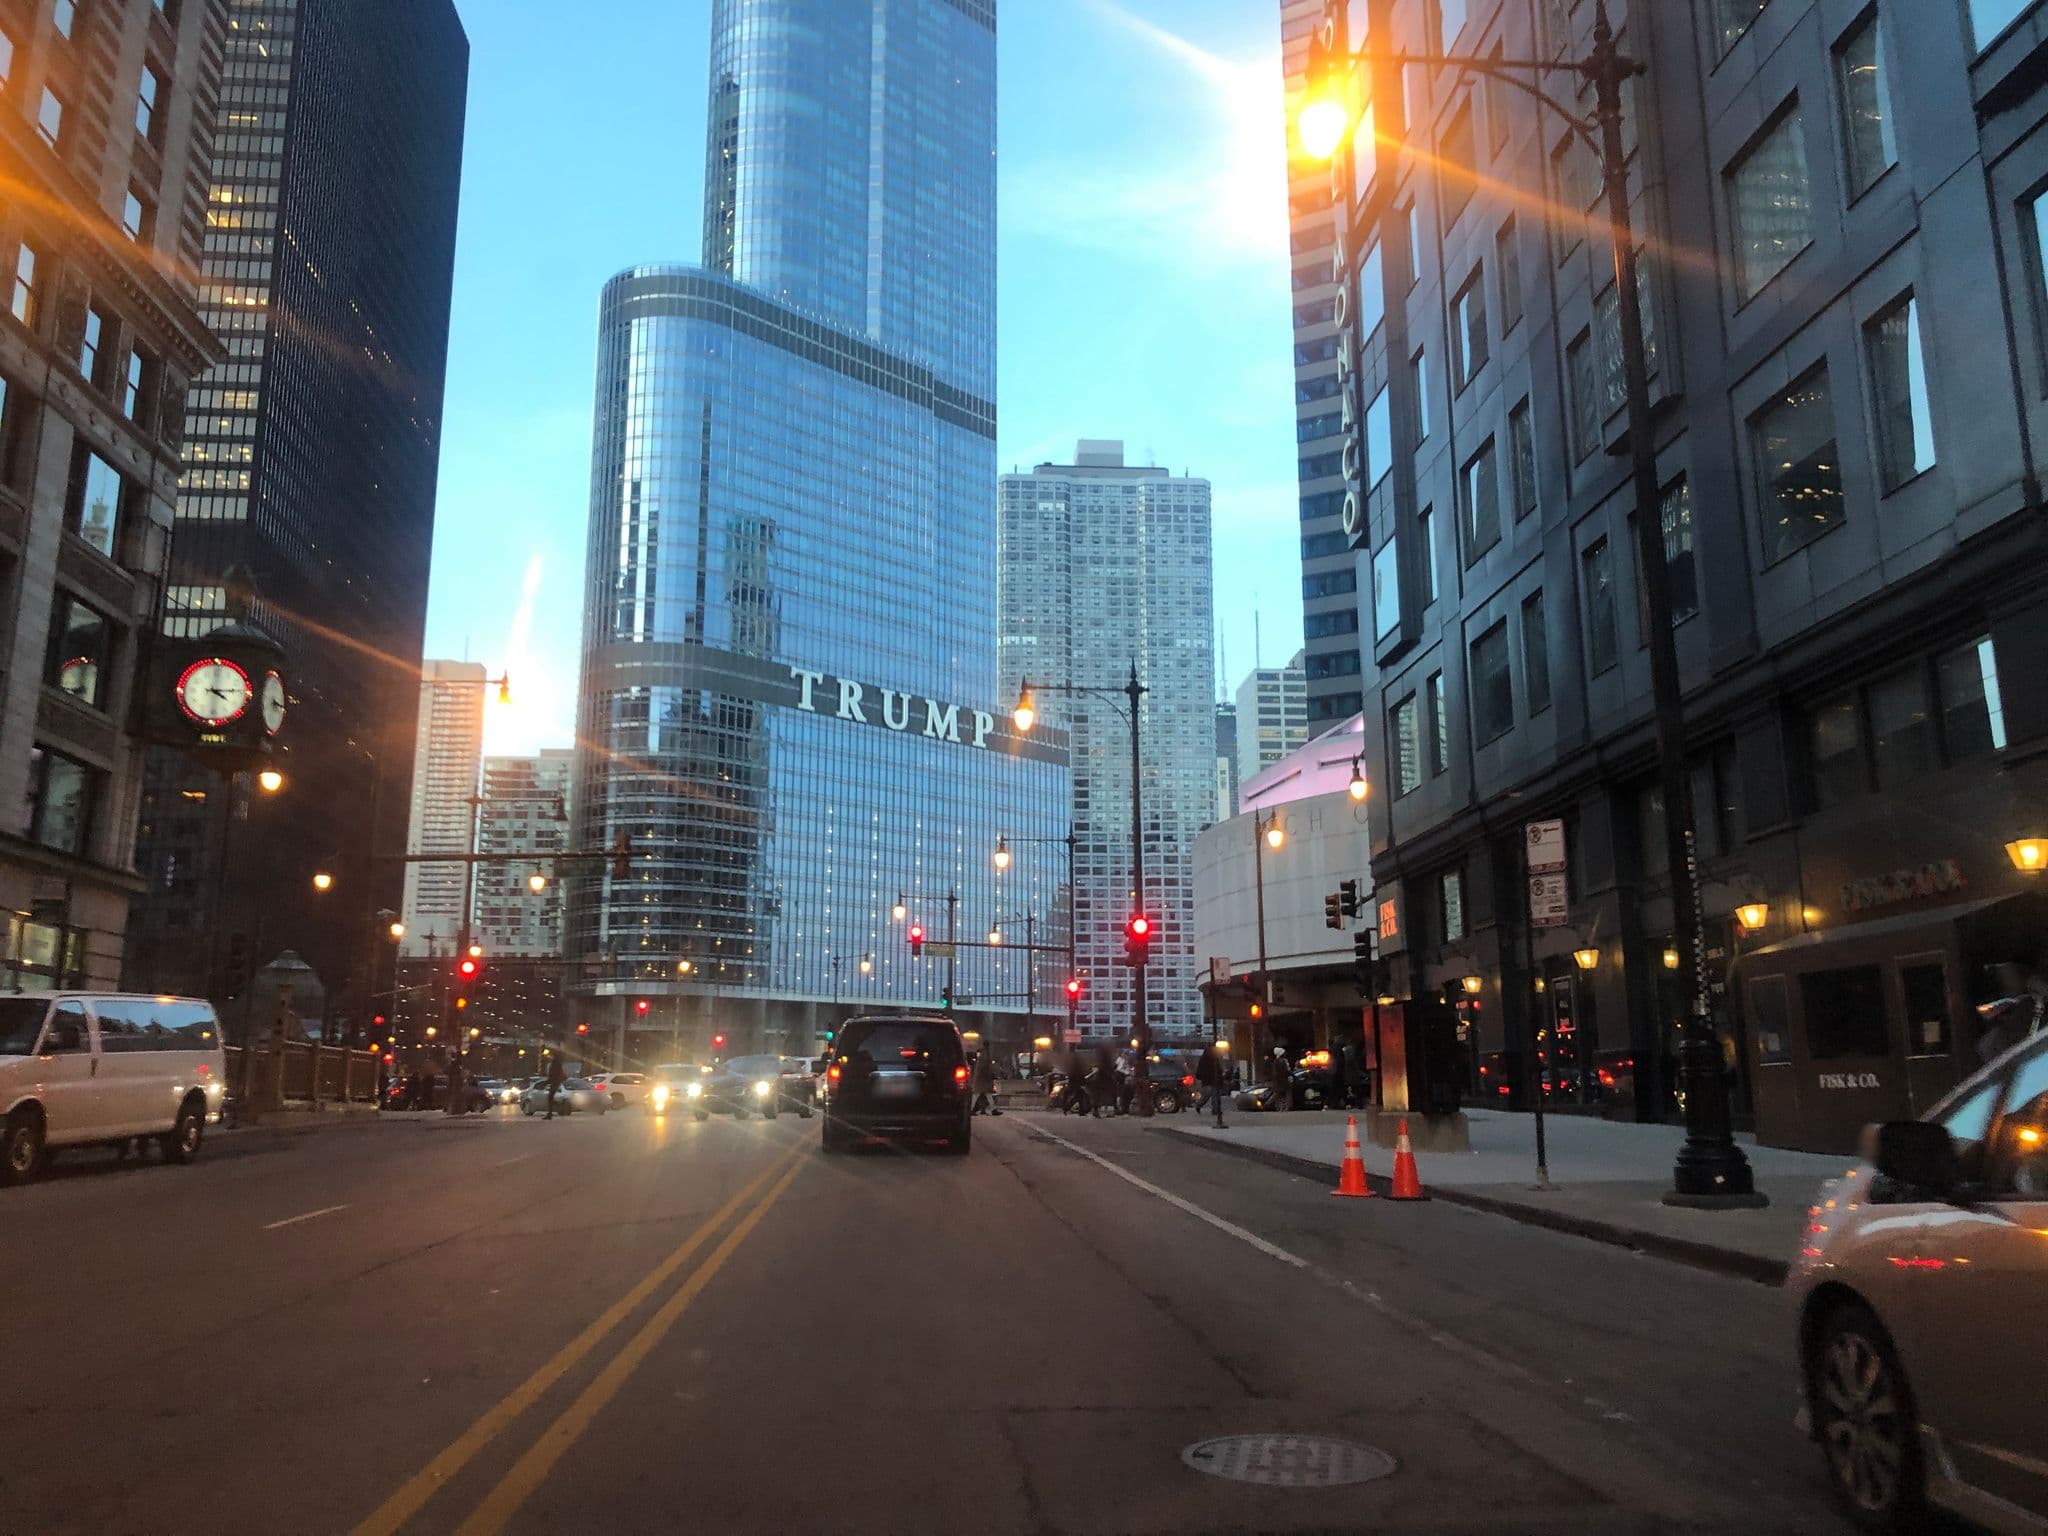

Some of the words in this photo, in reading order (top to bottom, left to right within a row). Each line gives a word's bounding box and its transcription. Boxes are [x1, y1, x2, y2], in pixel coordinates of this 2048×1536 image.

[1333, 238, 1361, 535] MONACO
[790, 666, 994, 748] TRUMP
[1819, 1073, 1846, 1088] FISK
[1847, 1073, 1858, 1088] &
[1859, 1072, 1880, 1088] CO.
